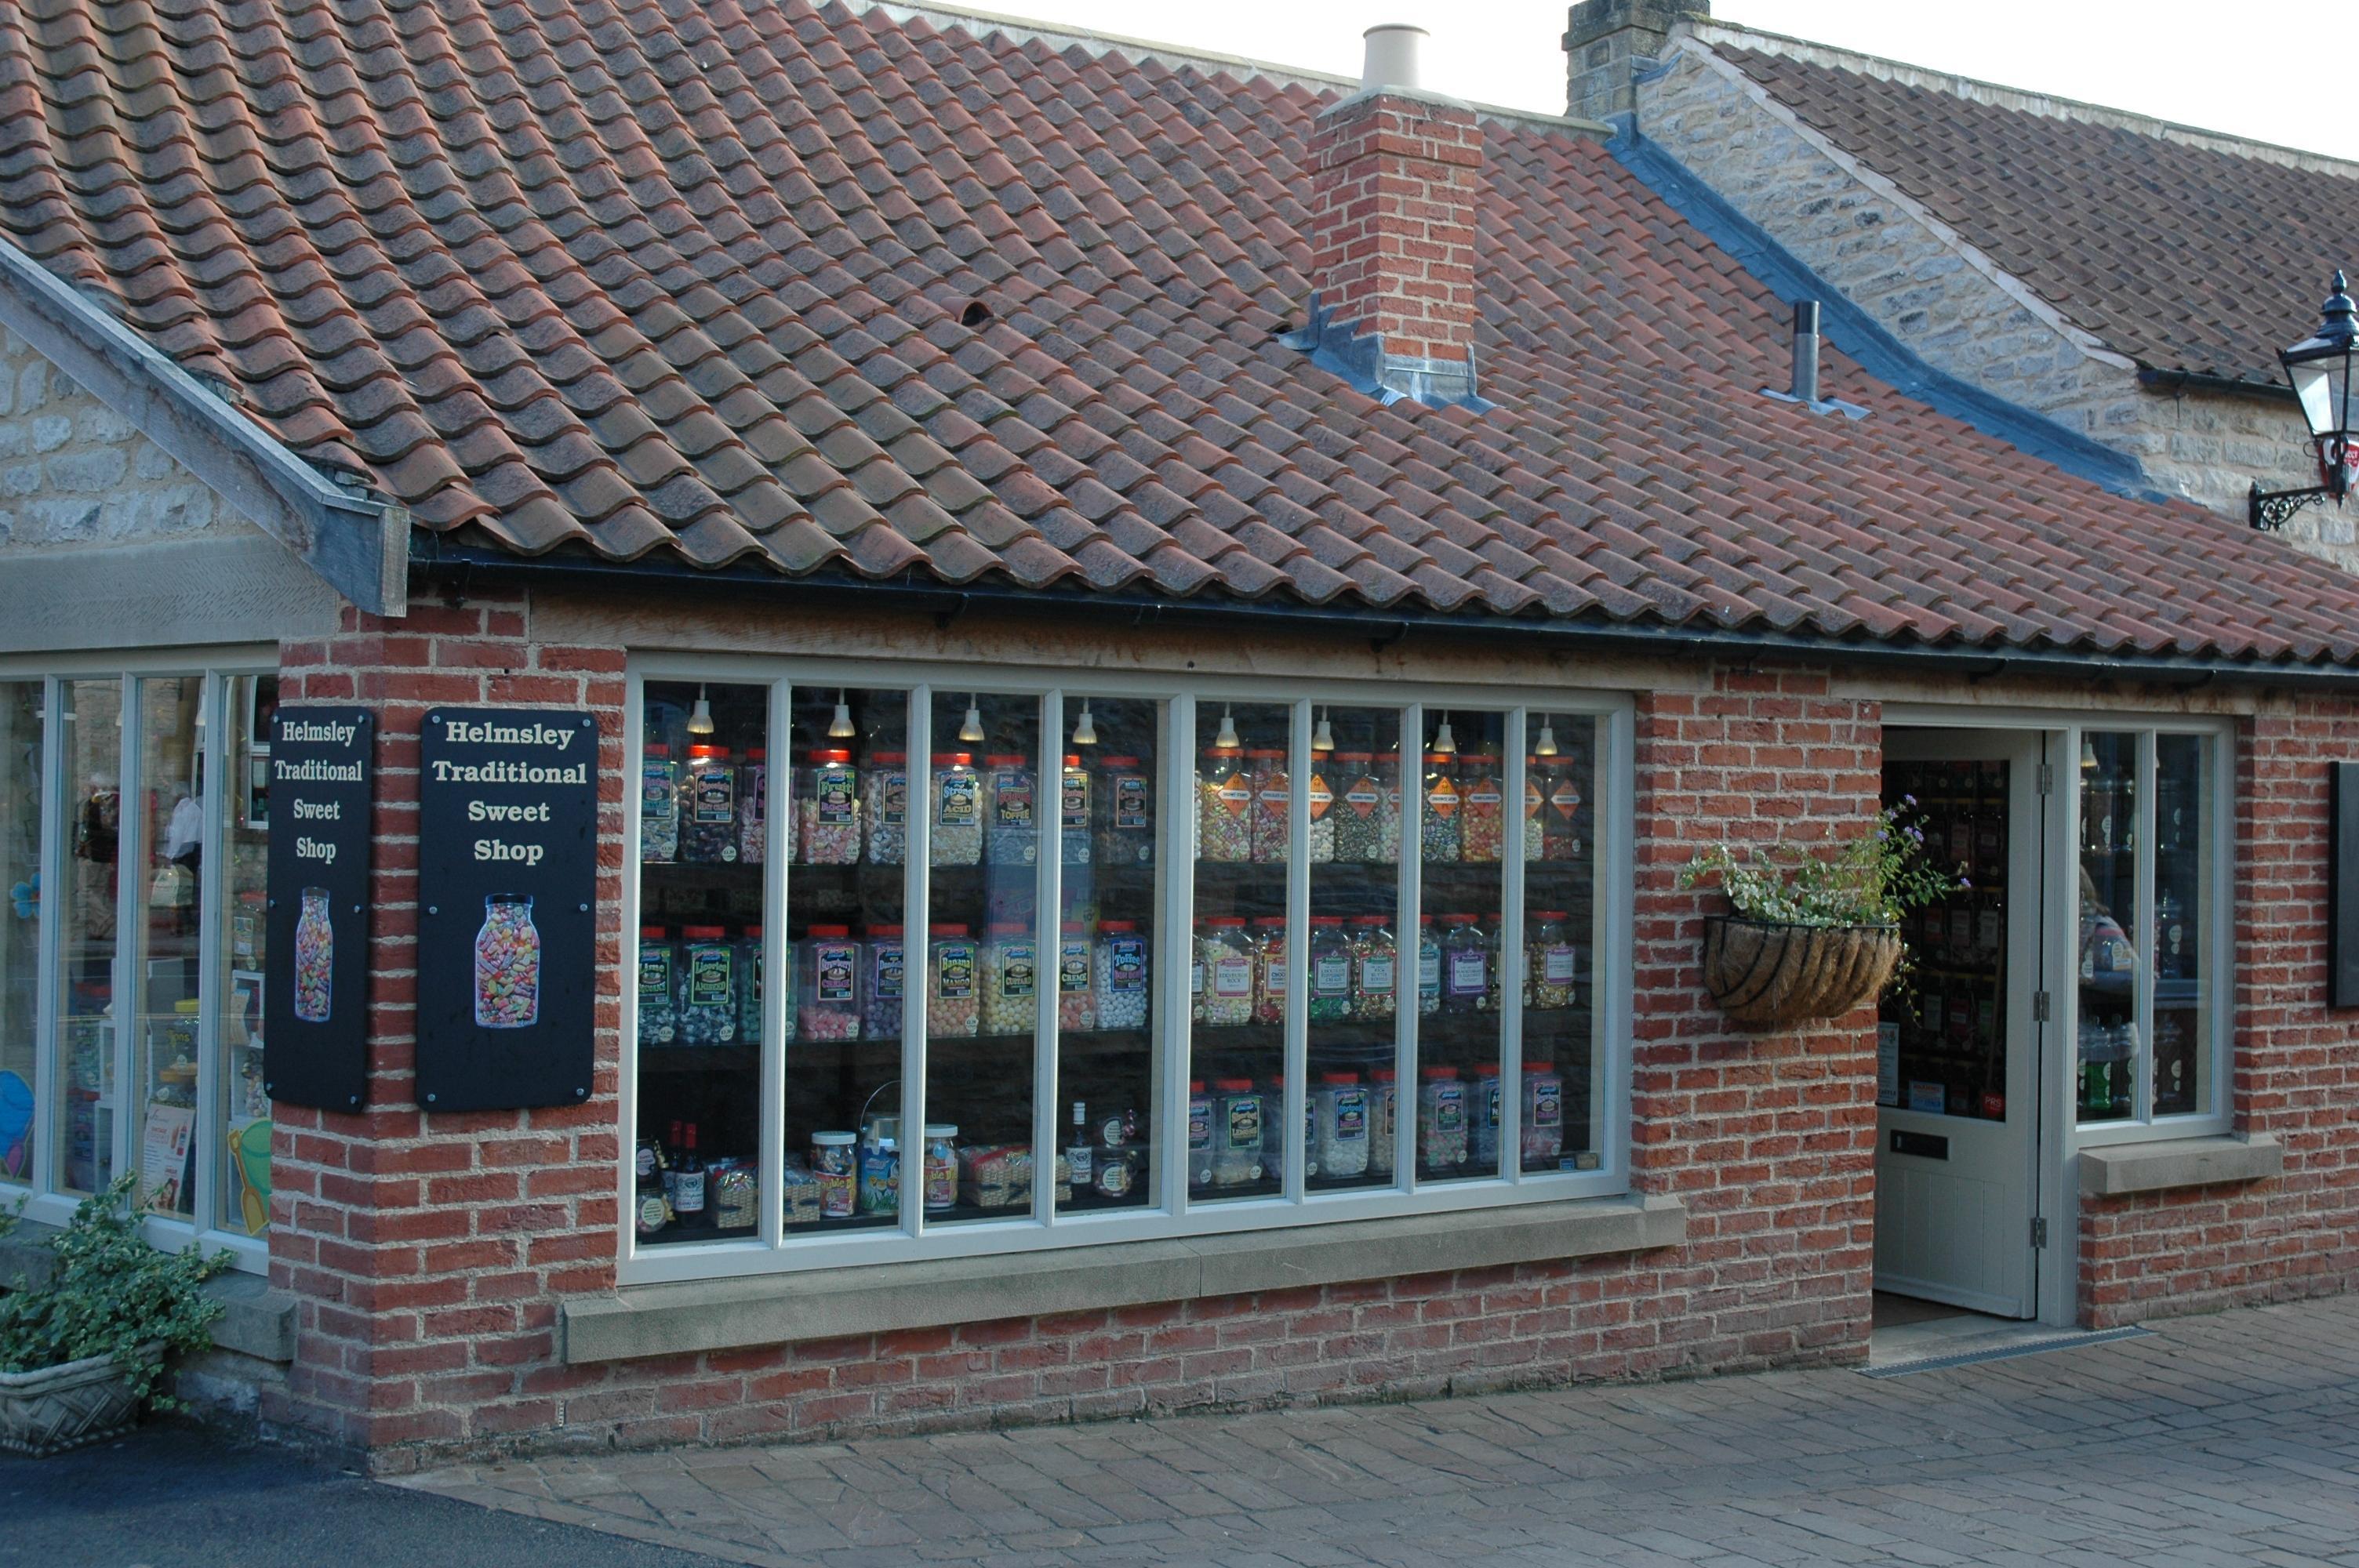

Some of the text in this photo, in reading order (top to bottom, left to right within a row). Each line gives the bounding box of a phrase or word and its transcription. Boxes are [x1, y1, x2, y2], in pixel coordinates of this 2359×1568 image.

[282, 720, 357, 747] Helmsley
[445, 721, 575, 750] Helmsley
[274, 759, 363, 782] Traditional
[432, 760, 587, 784] Traditional
[293, 798, 341, 820] Sweet
[468, 800, 551, 822] Sweet
[944, 804, 972, 813] ACID
[1001, 808, 1030, 820] TOFFEE
[296, 837, 336, 865] Shop
[474, 839, 543, 866] Shop
[942, 957, 971, 971] Banana
[1114, 953, 1141, 966] Toffee
[1985, 1096, 2002, 1108] PRS
